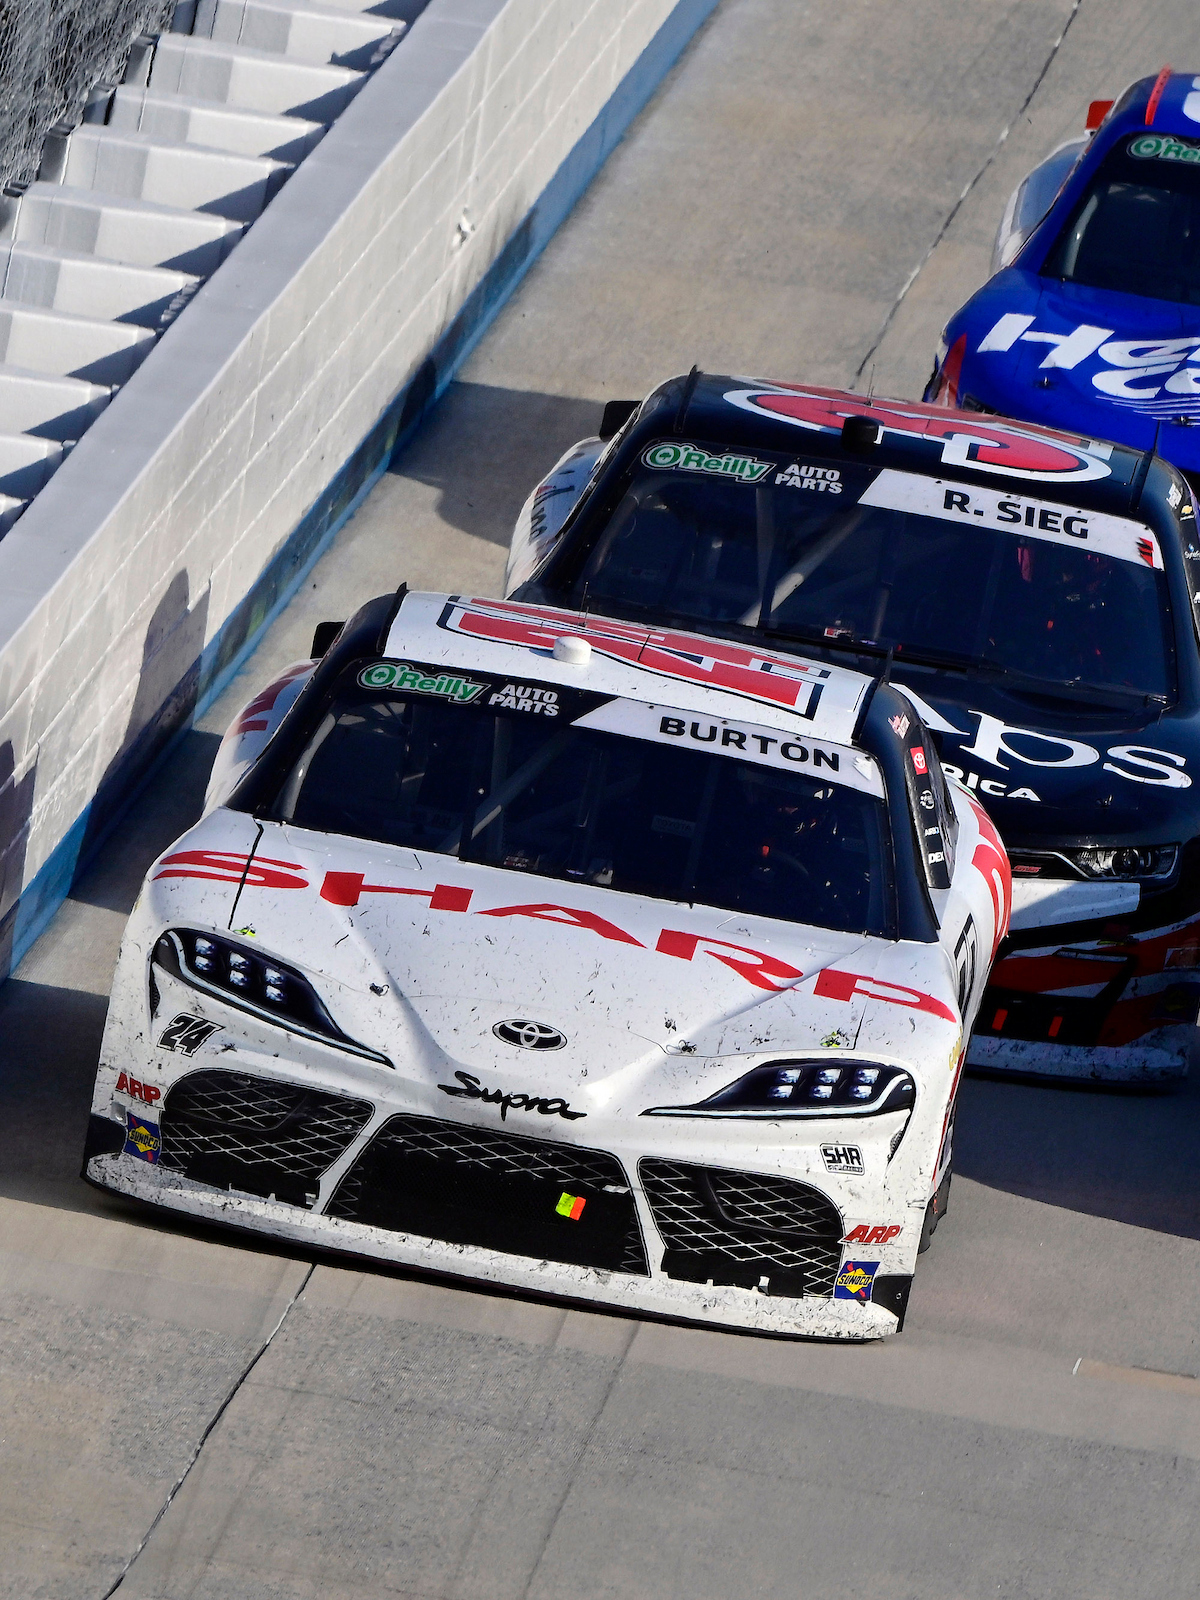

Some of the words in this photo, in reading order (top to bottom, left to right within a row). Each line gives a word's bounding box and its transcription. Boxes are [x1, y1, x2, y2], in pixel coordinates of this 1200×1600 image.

[647, 443, 770, 480] O'Reilly
[784, 463, 841, 482] AUTO
[774, 473, 843, 495] PARTS
[943, 489, 985, 516] R.
[996, 501, 1090, 540] SIEG
[360, 663, 480, 700] O'Reilly
[500, 683, 559, 704] AUTO
[488, 693, 560, 717] PARTS
[659, 716, 841, 773] BURTON
[153, 850, 958, 1023] SHARP
[158, 1013, 223, 1056] 24
[116, 1072, 161, 1104] ARP
[437, 1071, 588, 1121] Supra
[129, 1129, 161, 1150] SUNOCO
[823, 1146, 863, 1166] SHR
[843, 1224, 901, 1244] ARP
[838, 1273, 871, 1288] SUNOCO
